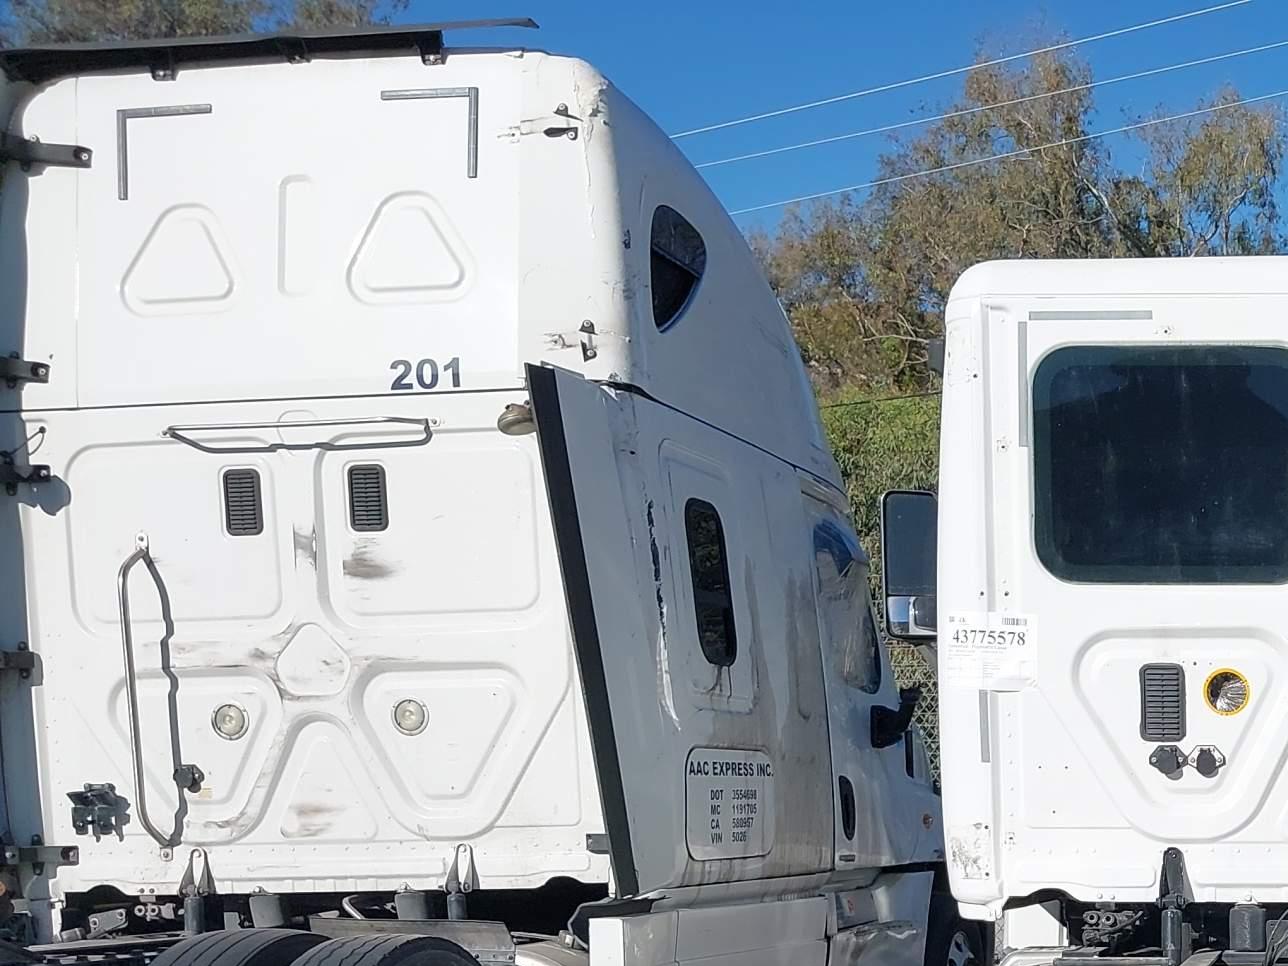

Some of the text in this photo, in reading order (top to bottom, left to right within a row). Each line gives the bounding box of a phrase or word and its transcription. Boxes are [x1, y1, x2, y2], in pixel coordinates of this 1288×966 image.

[389, 357, 461, 390] 201
[952, 629, 1026, 646] 43775578
[689, 761, 774, 777] AAC EXPRESS INC.
[711, 789, 724, 800] DOT
[711, 804, 720, 815] MC
[711, 818, 720, 829] CA
[711, 832, 722, 844] VIN
